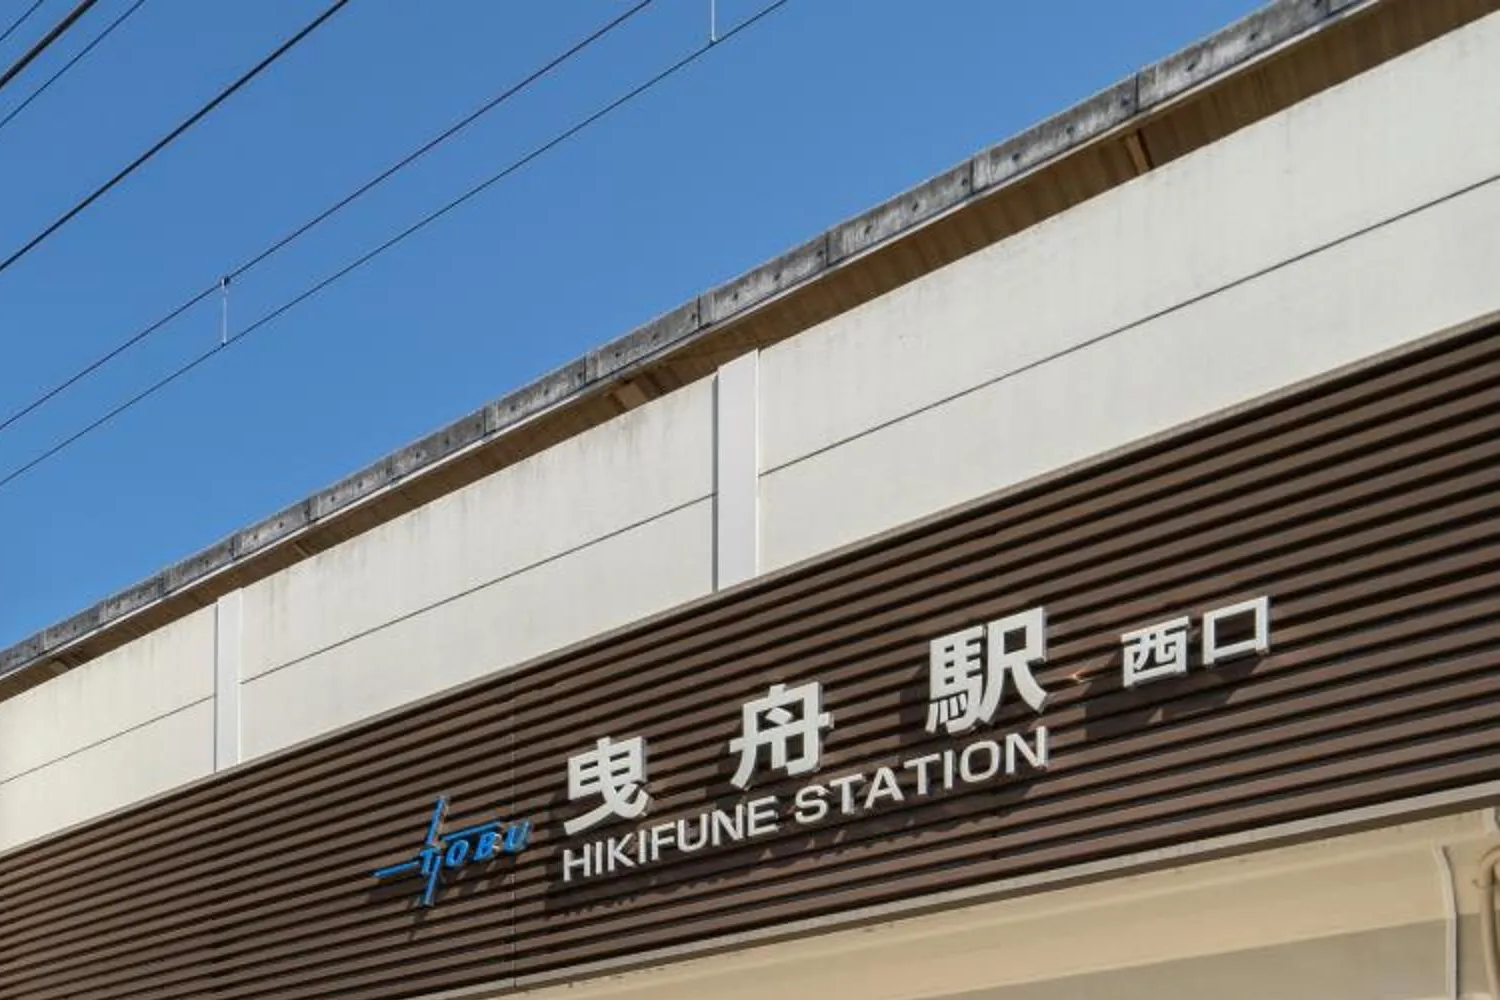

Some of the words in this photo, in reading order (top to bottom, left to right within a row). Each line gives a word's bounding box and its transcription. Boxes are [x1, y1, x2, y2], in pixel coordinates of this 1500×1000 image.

[563, 796, 781, 882] HIKIFUNE
[795, 725, 1049, 824] STATION
[564, 606, 1048, 836] 曳舟駅
[1121, 595, 1270, 688] 西口
